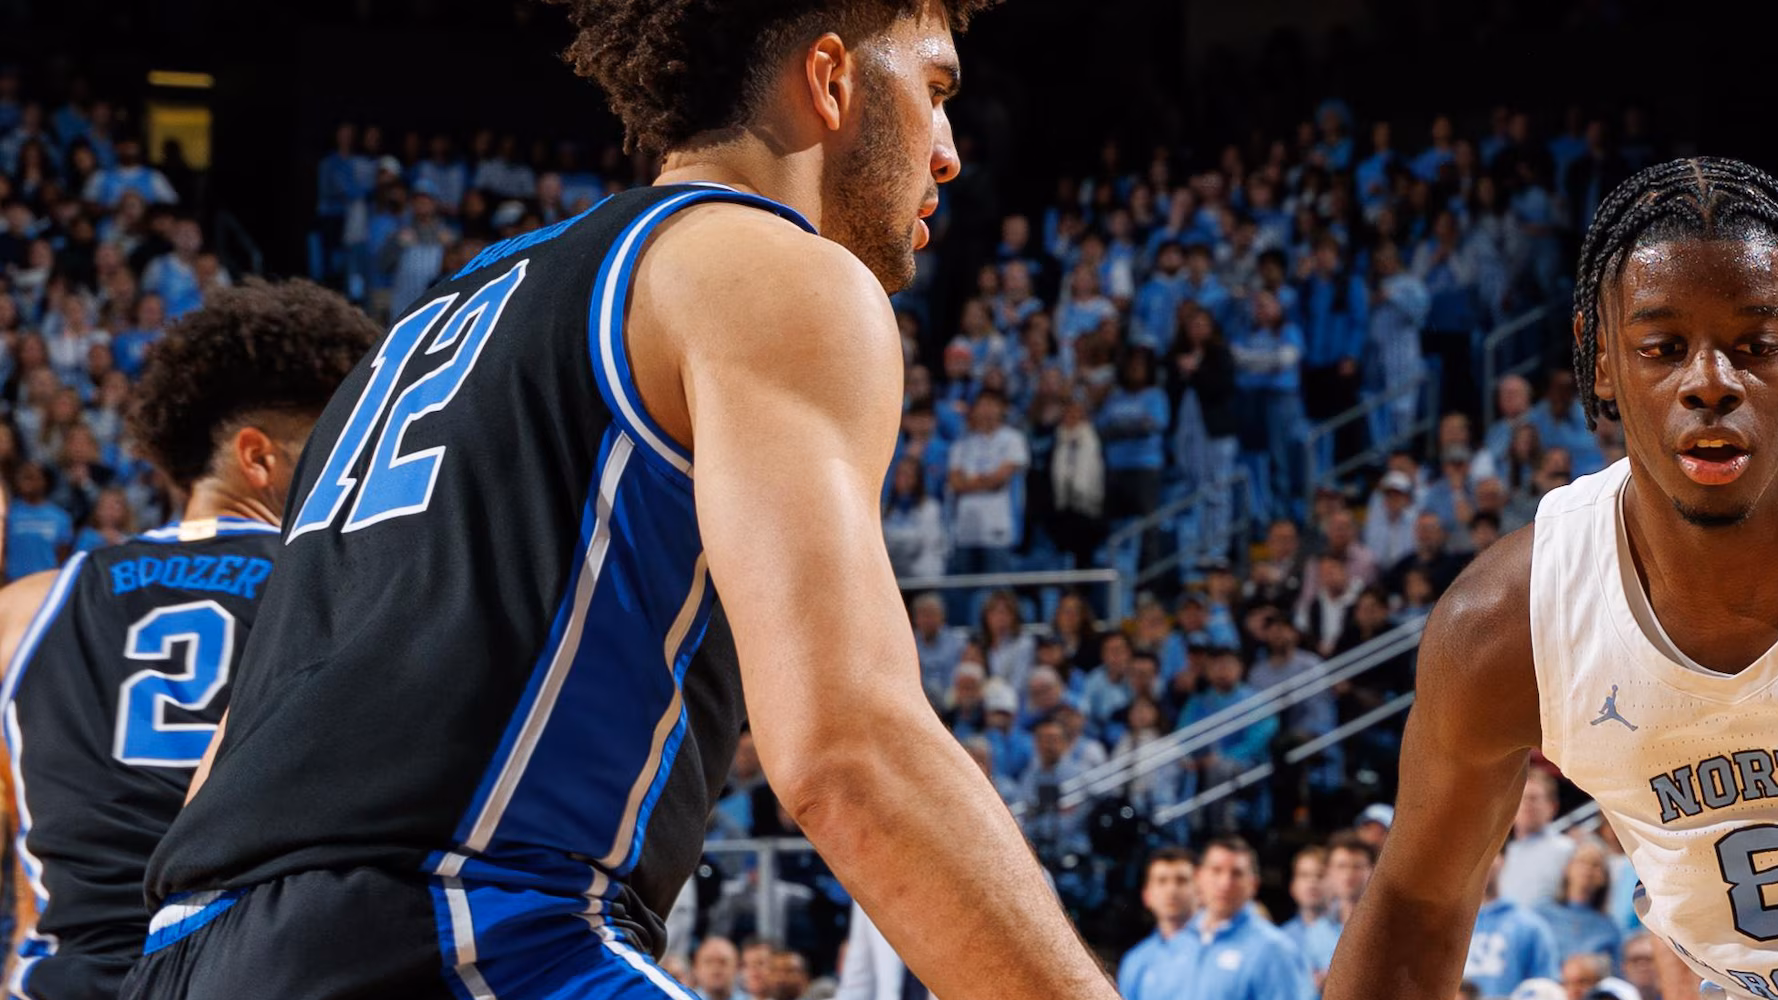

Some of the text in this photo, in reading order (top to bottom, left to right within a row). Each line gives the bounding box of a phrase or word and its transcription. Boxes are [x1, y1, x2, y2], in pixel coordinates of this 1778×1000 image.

[285, 258, 530, 546] 12
[109, 555, 274, 600] BOOZER
[112, 599, 236, 768] 2
